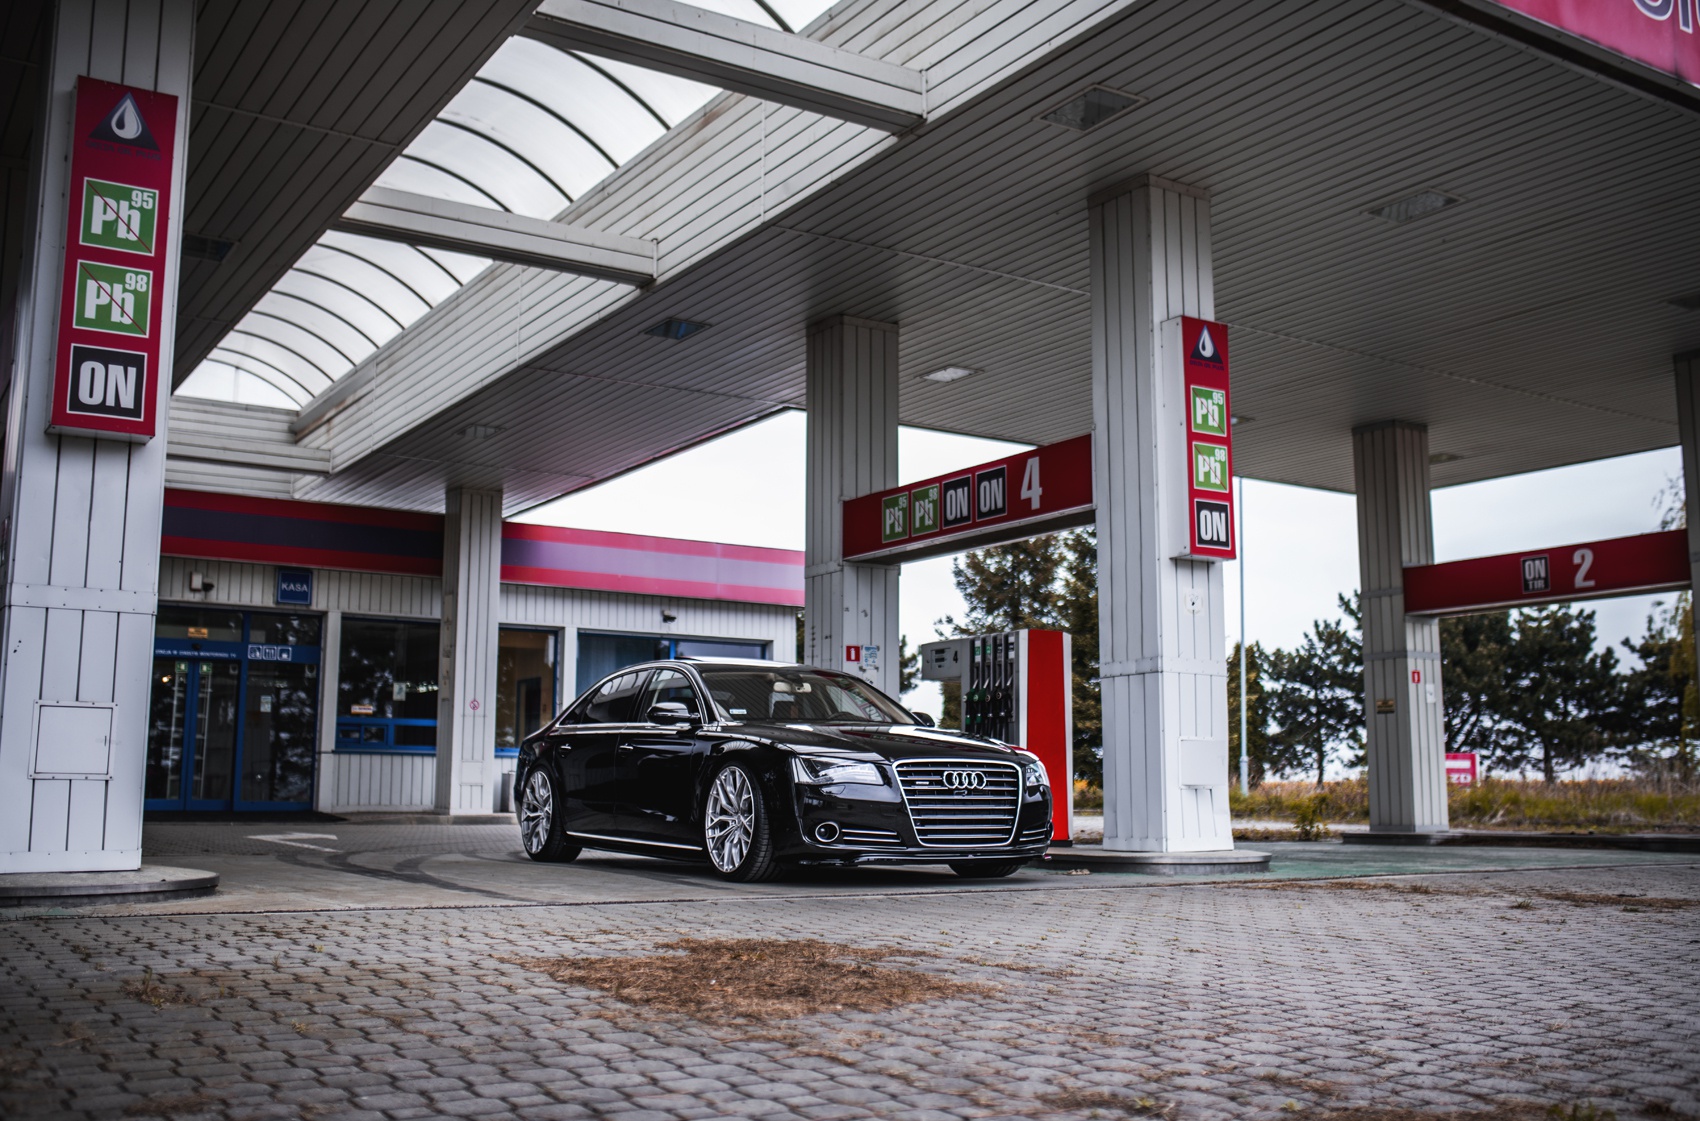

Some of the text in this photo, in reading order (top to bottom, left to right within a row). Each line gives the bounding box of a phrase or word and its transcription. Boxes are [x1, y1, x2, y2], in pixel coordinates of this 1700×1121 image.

[77, 360, 137, 409] ON
[946, 487, 968, 521] ON
[980, 478, 1003, 513] ON
[1020, 456, 1042, 510] 4
[1199, 509, 1226, 542] ON
[1525, 549, 1595, 588] ON 2
[1527, 580, 1545, 590] TIR
[281, 582, 308, 592] KASA
[952, 650, 959, 663] 4
